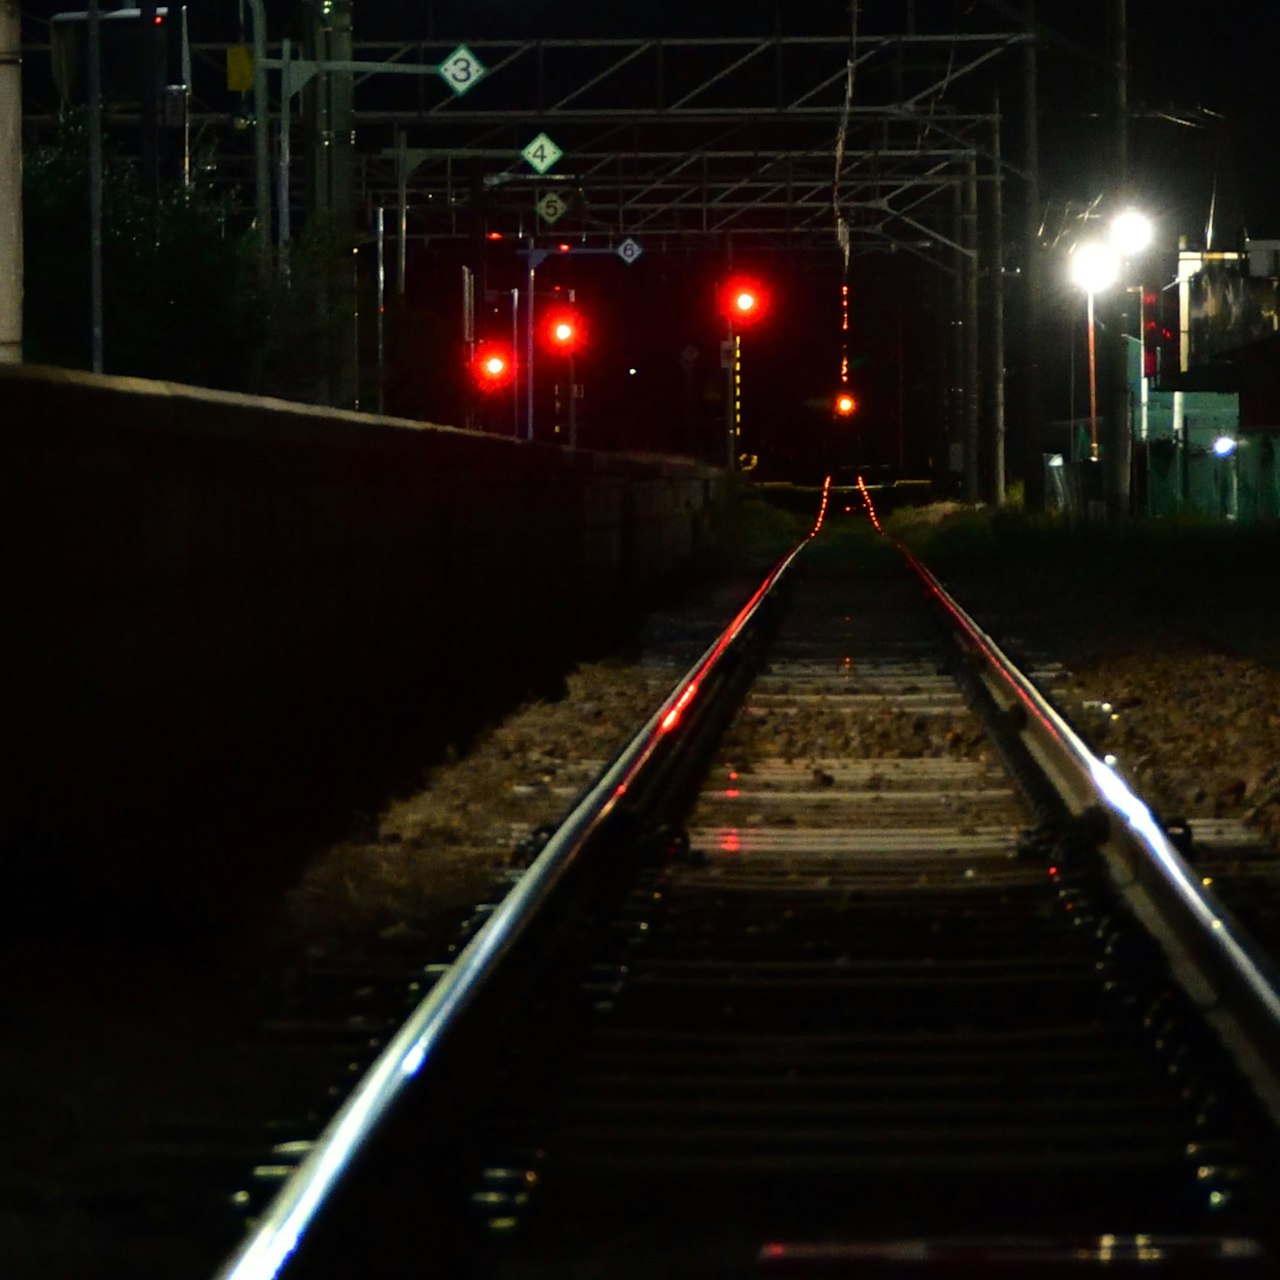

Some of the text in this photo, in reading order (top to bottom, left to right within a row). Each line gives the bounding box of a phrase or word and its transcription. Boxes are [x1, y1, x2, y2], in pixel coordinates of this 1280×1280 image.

[452, 58, 471, 82] 3
[533, 144, 547, 163] 4
[545, 199, 558, 217] 5
[624, 243, 634, 258] 6
